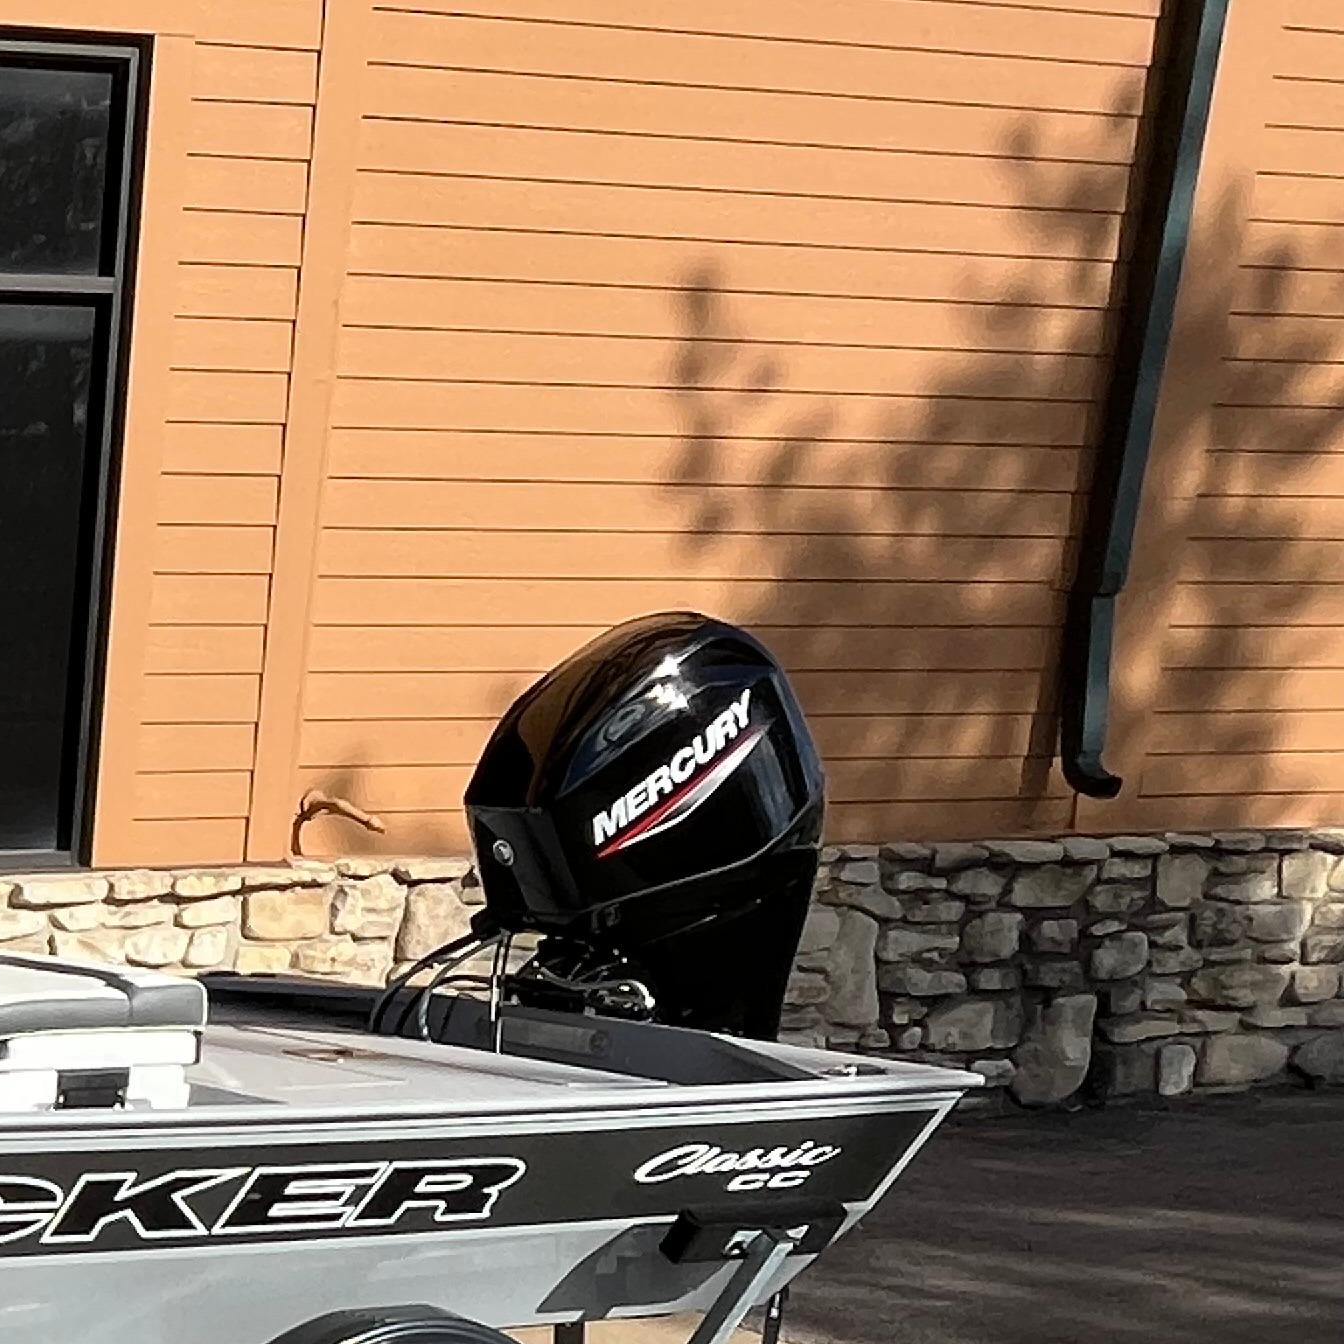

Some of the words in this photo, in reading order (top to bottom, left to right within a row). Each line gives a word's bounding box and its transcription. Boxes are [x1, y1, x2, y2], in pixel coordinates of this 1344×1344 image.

[592, 688, 751, 846] MERCURY
[633, 1140, 842, 1184] Classic
[726, 1170, 811, 1192] CC
